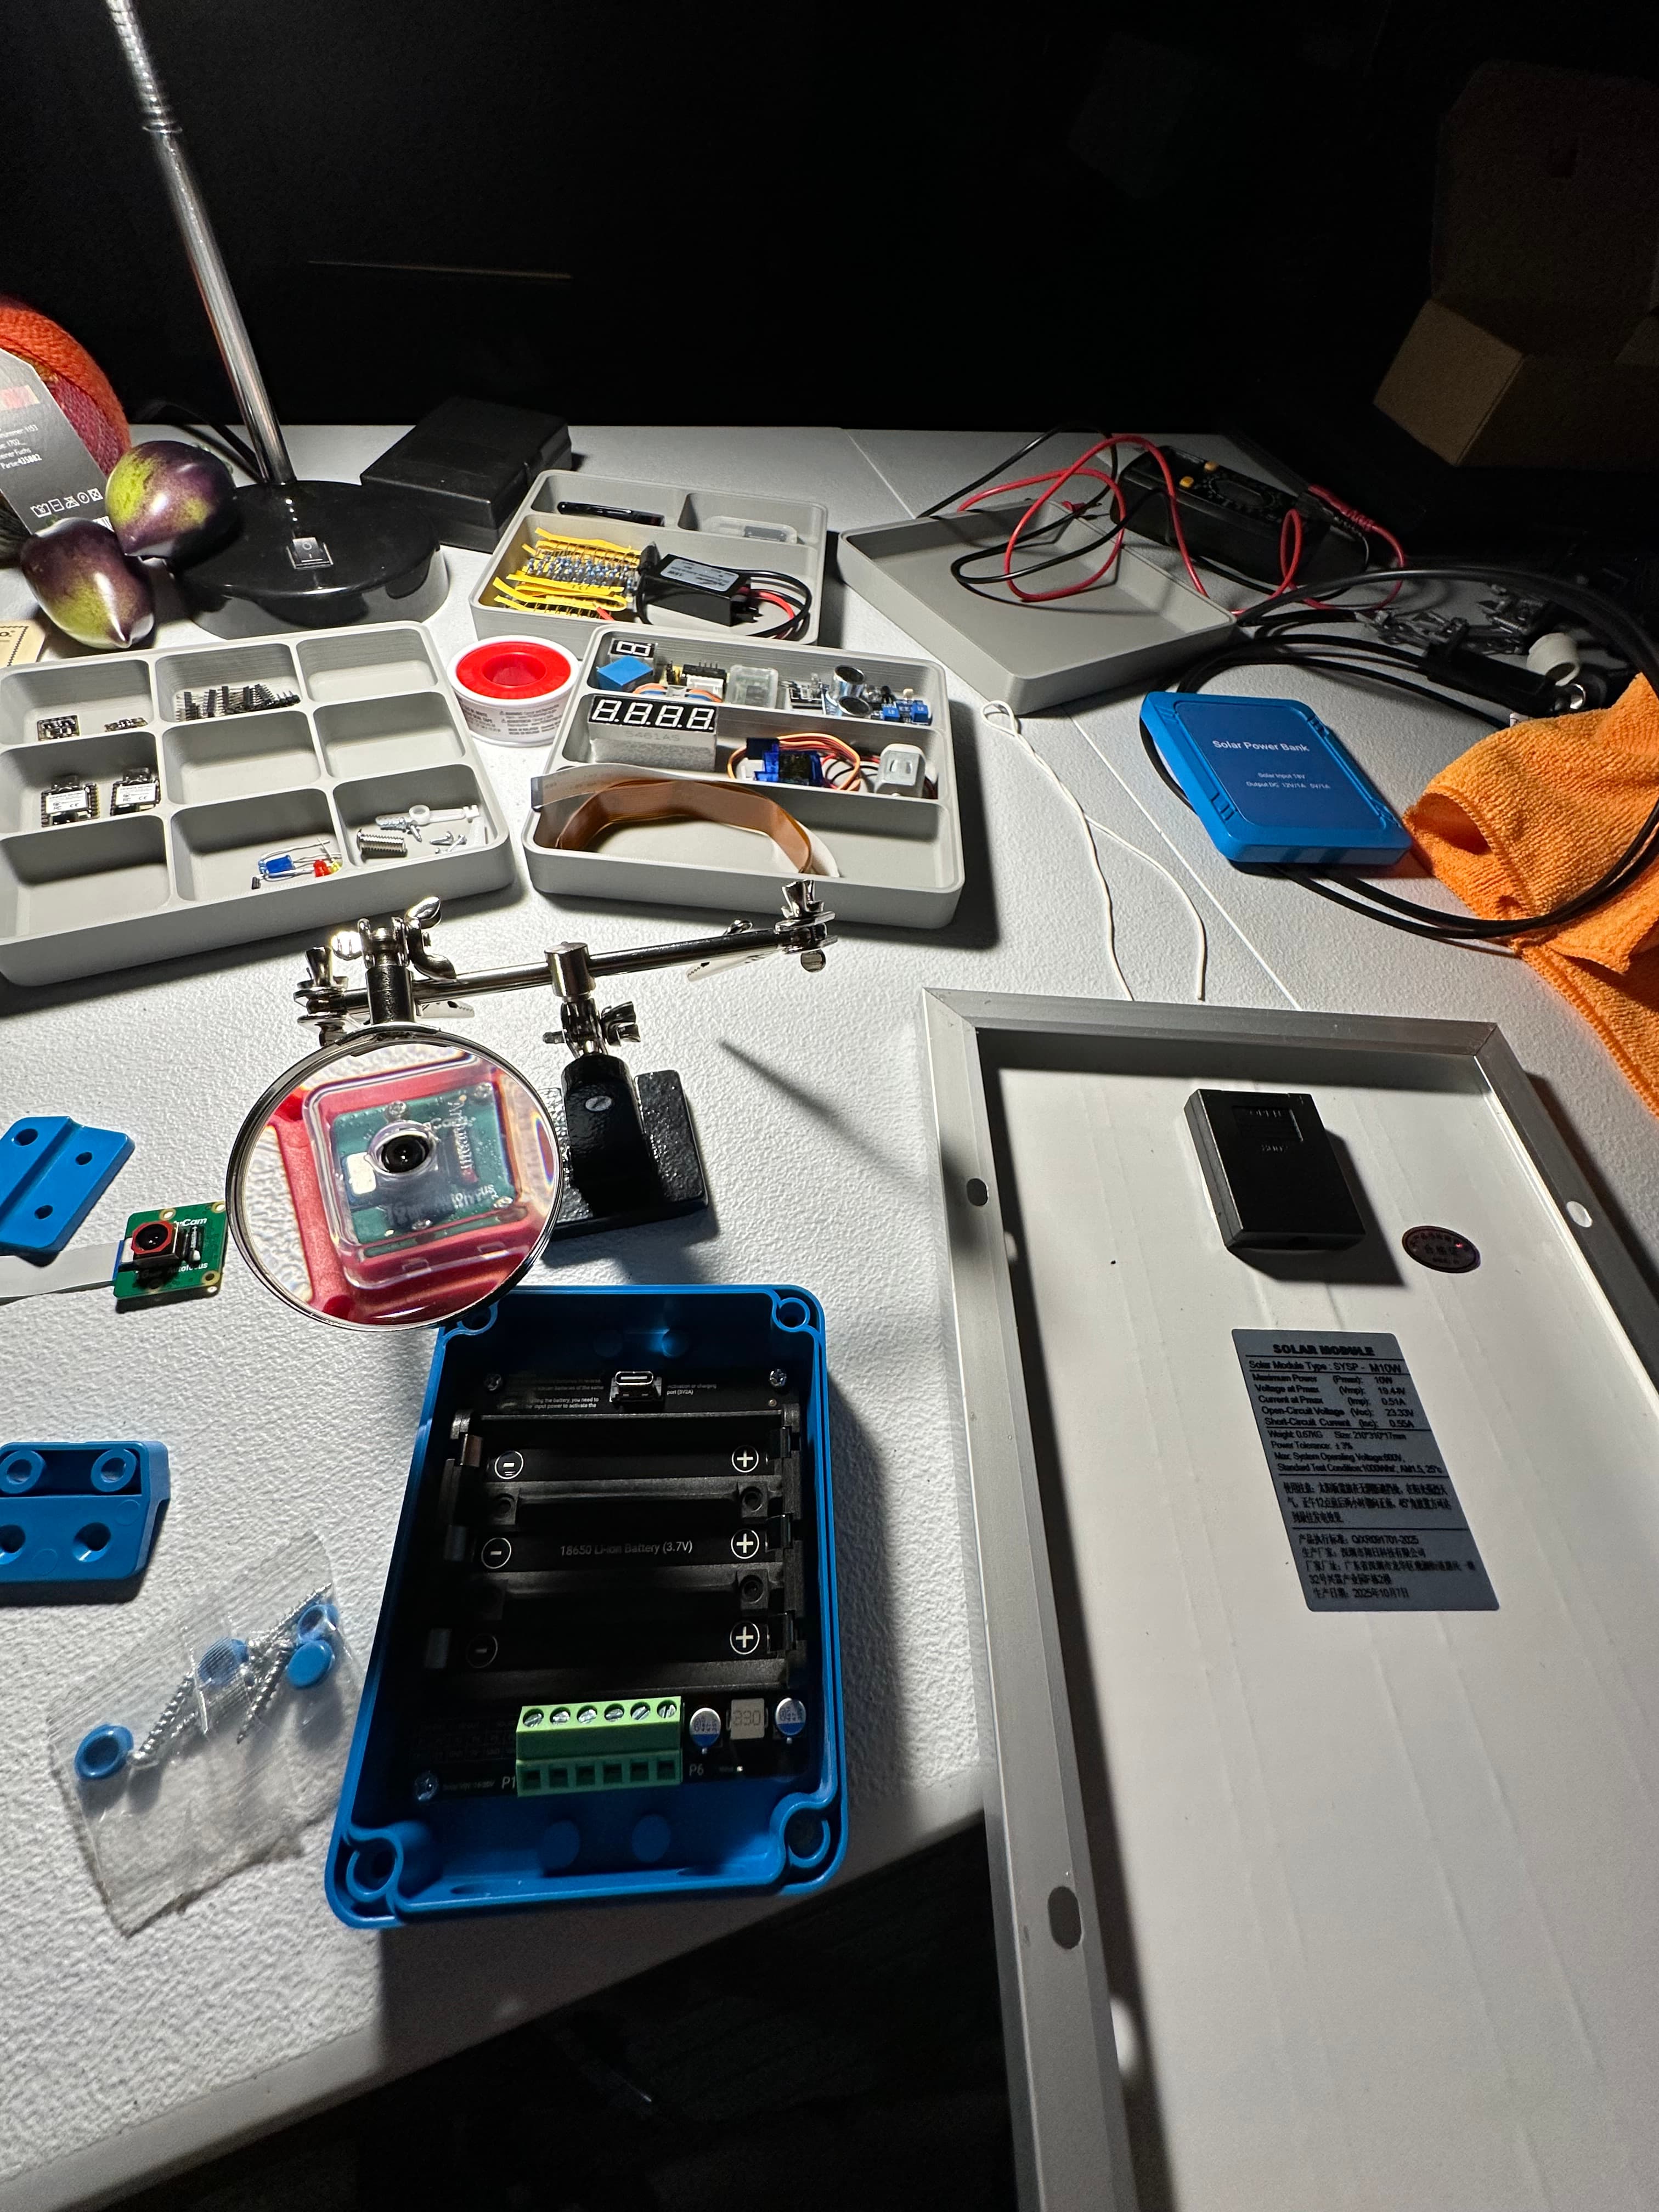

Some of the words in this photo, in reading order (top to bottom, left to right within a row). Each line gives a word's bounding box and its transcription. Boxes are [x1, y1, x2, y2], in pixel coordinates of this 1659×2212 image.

[1212, 740, 1242, 749] Solar
[1243, 742, 1279, 751] Power
[1280, 743, 1310, 752] Bank
[1273, 1344, 1318, 1354] SOLAR
[1319, 1346, 1375, 1356] MODULE
[1272, 1361, 1304, 1369] Module
[1305, 1362, 1327, 1372] Type
[1255, 1384, 1285, 1393] Voltage
[1259, 1395, 1289, 1403] Current
[1313, 1407, 1345, 1417] Voltage
[1319, 1418, 1351, 1426] Current
[560, 1544, 591, 1556] 18650
[624, 1542, 660, 1555] Battery
[662, 1541, 693, 1554] (3.7V)
[689, 1764, 704, 1776] P6
[501, 1775, 516, 1790] P1
